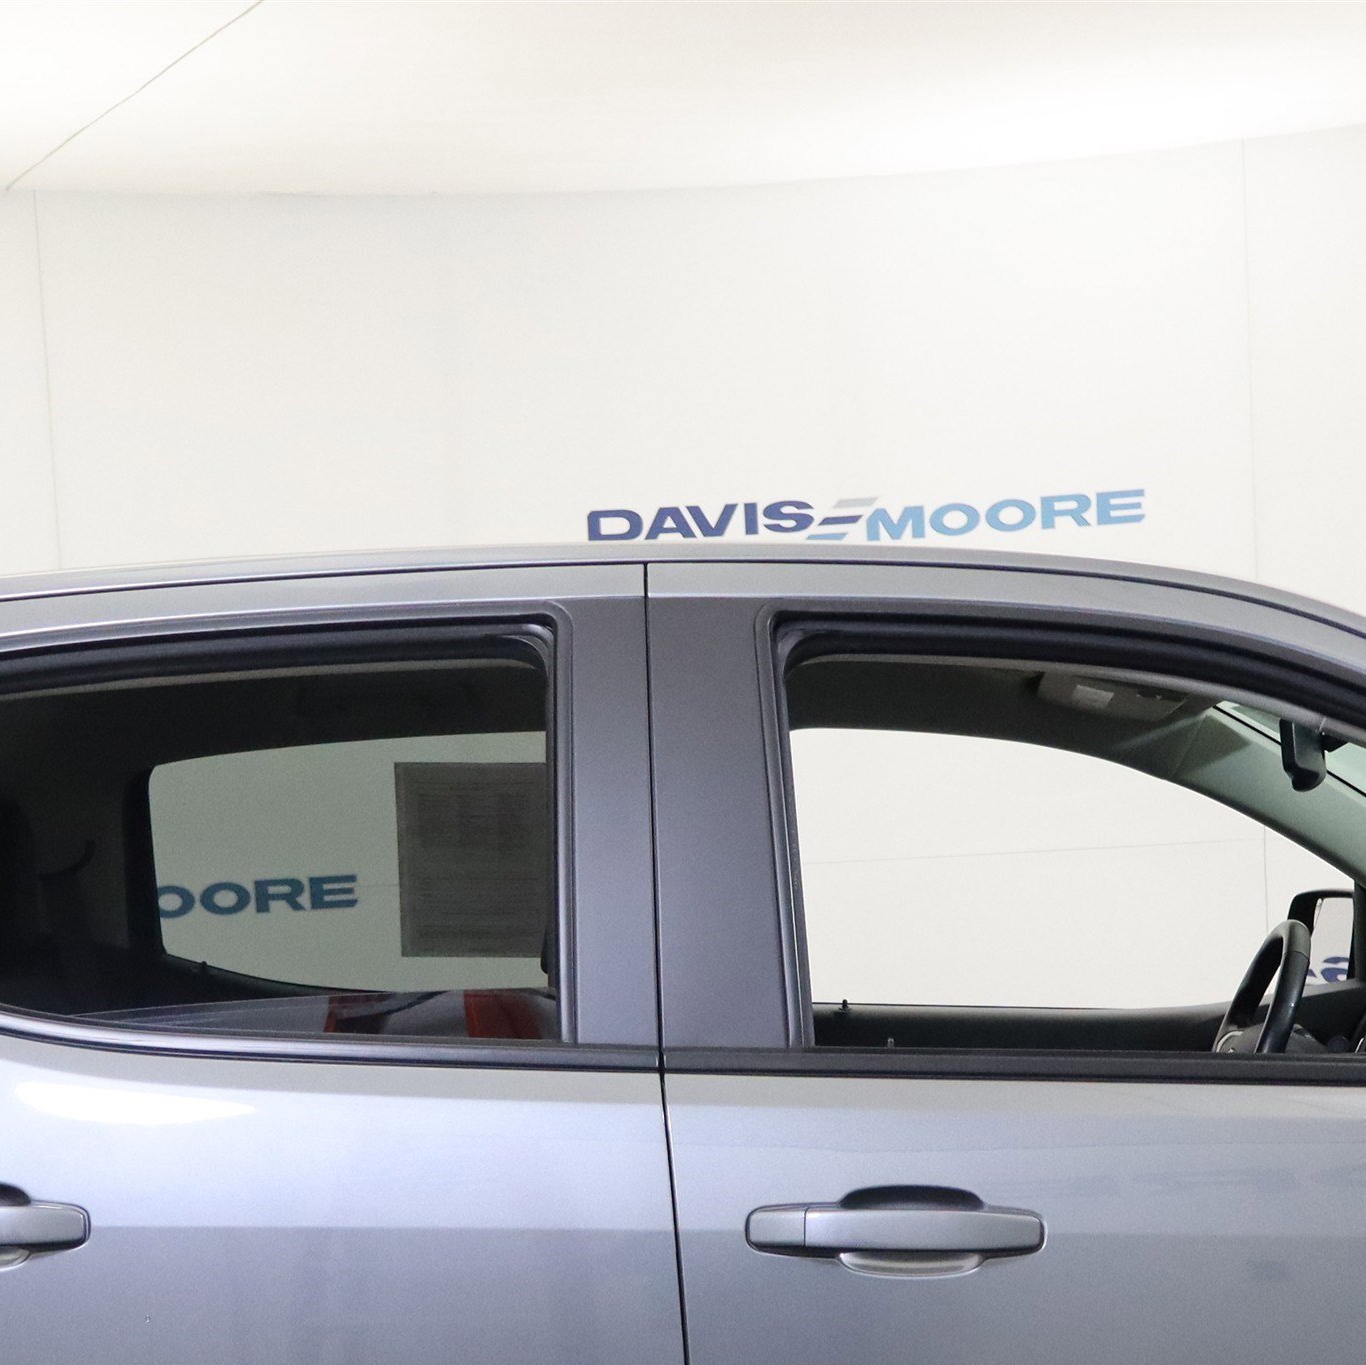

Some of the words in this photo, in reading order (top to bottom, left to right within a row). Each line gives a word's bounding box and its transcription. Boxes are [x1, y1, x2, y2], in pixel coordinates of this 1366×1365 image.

[587, 500, 814, 541] DAVIS
[866, 489, 1146, 541] MOORE
[157, 874, 358, 918] OORE
